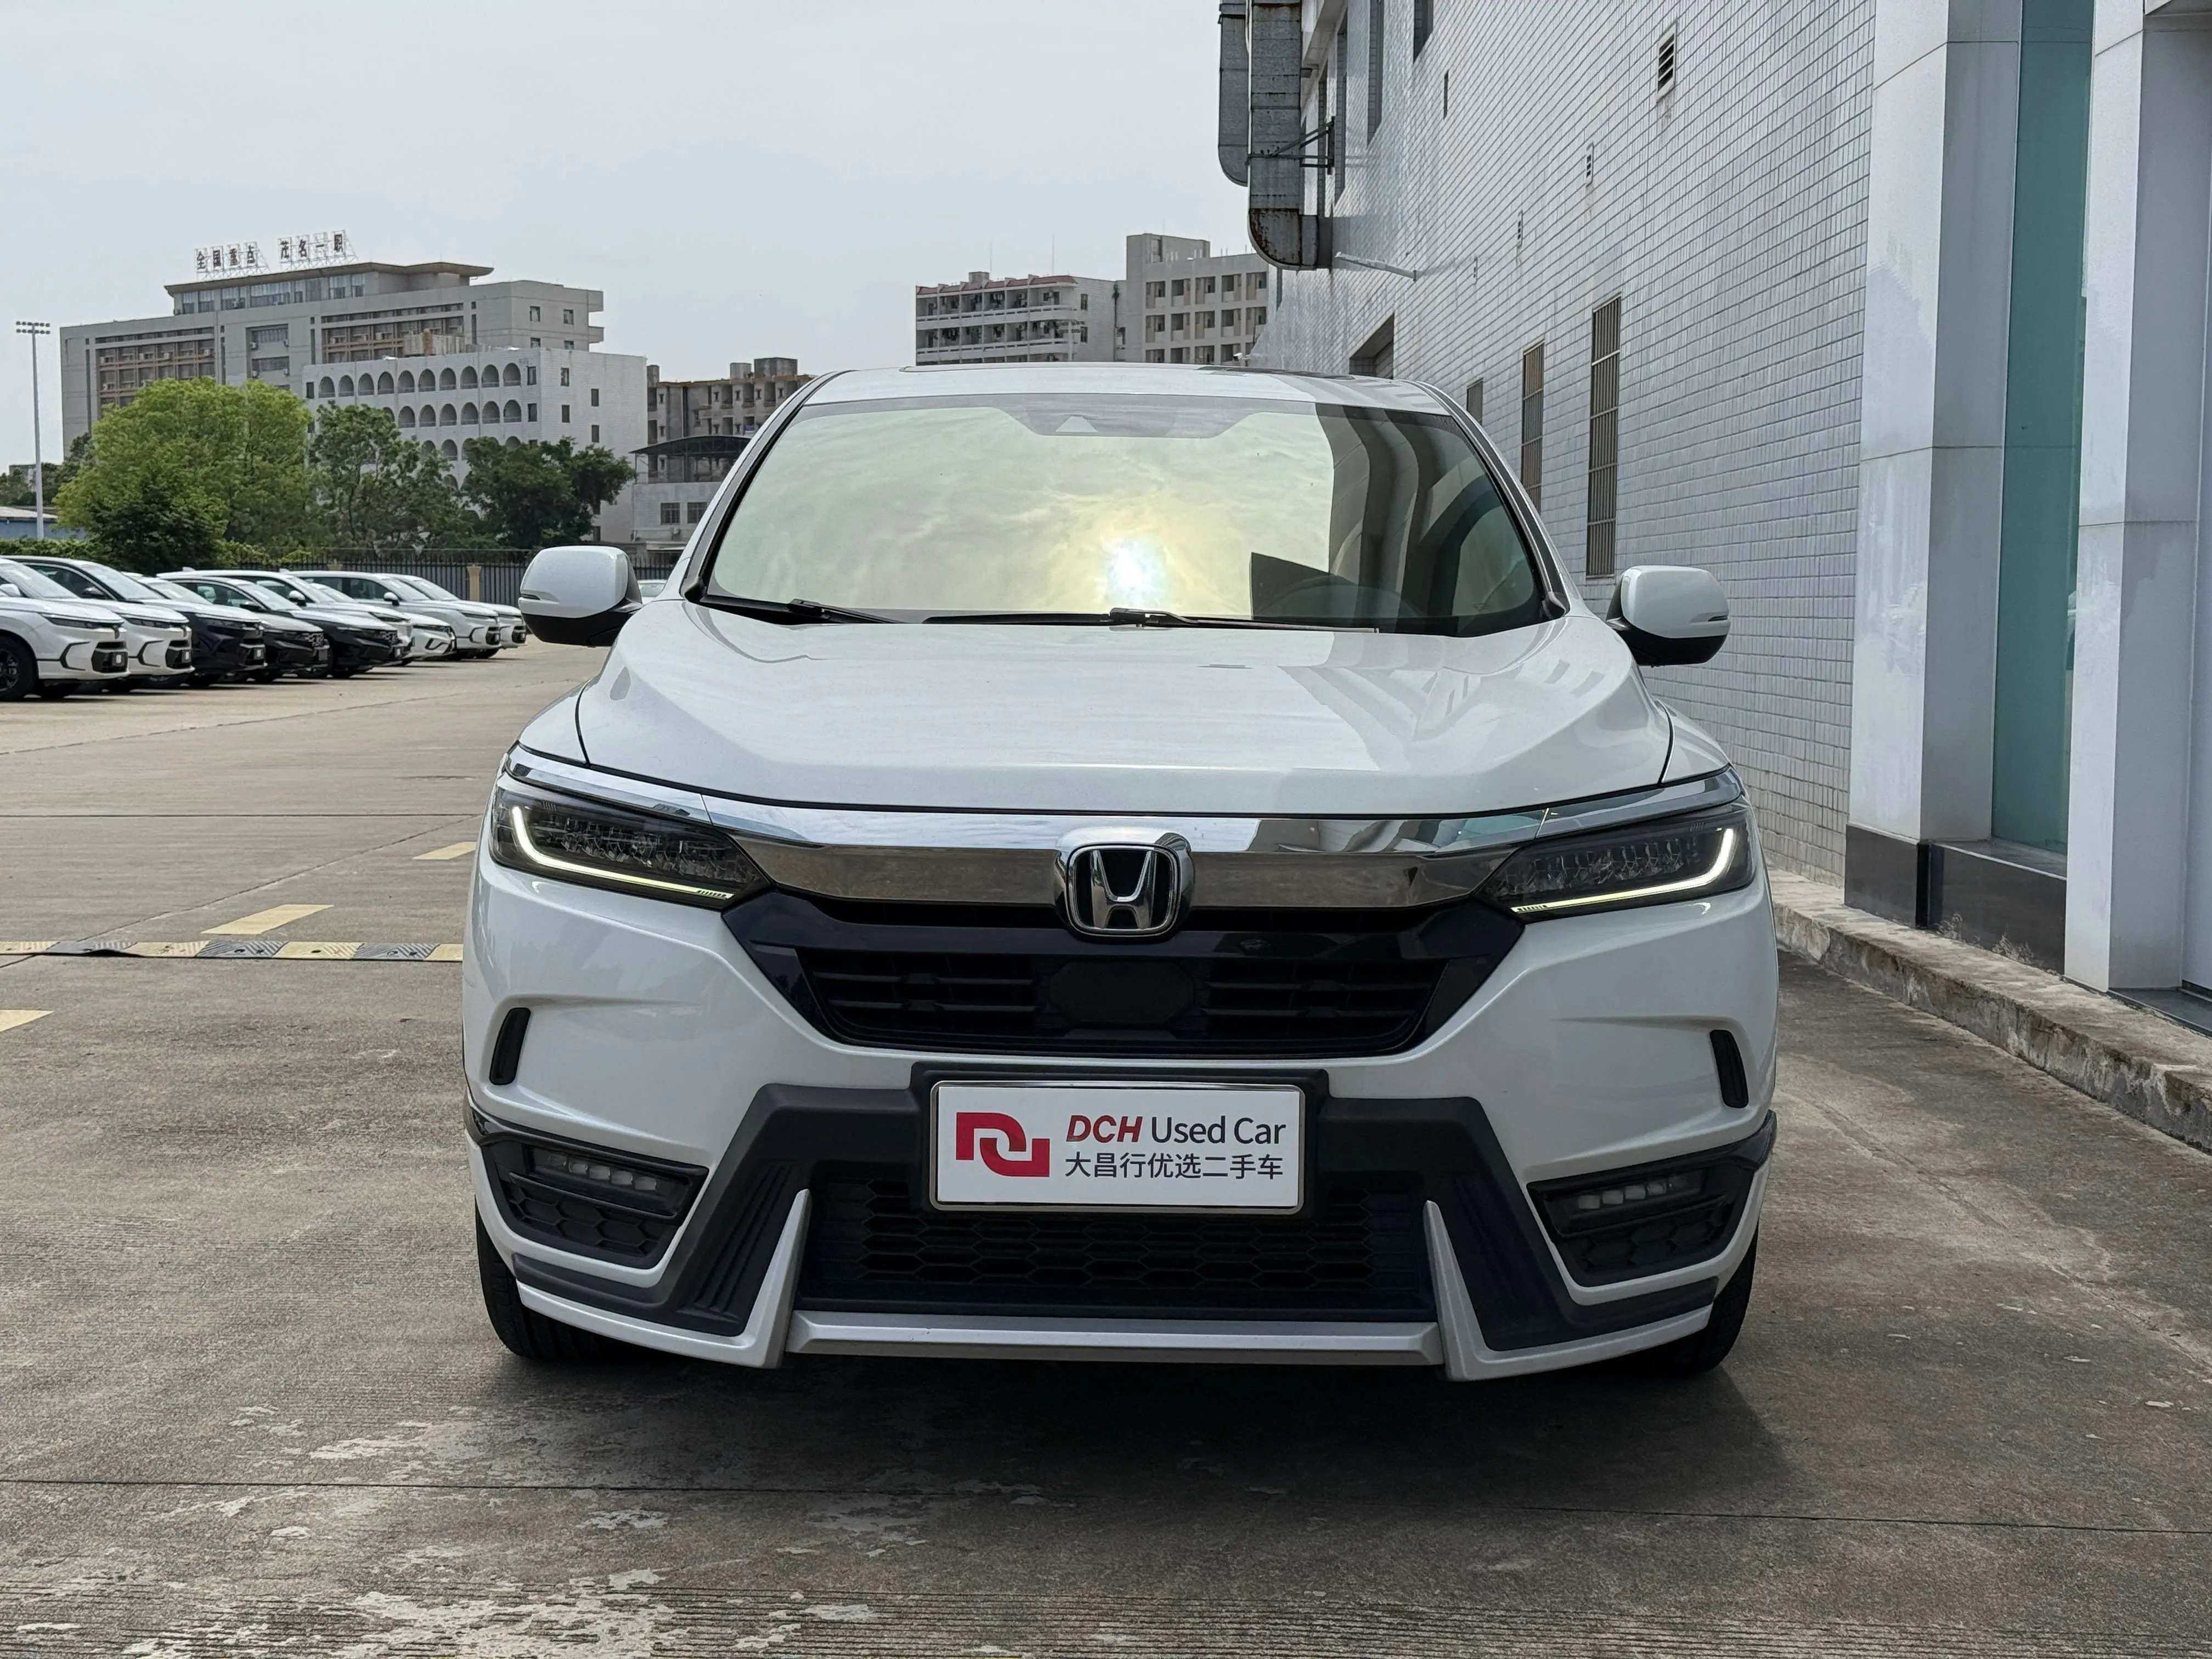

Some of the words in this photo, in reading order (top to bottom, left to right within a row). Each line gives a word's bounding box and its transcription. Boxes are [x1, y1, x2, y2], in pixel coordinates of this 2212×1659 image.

[1065, 1115, 1144, 1143] DCH
[1152, 1115, 1227, 1145] Used
[1234, 1117, 1288, 1145] Car
[1065, 1151, 1284, 1181] 大昌行优选二手车
